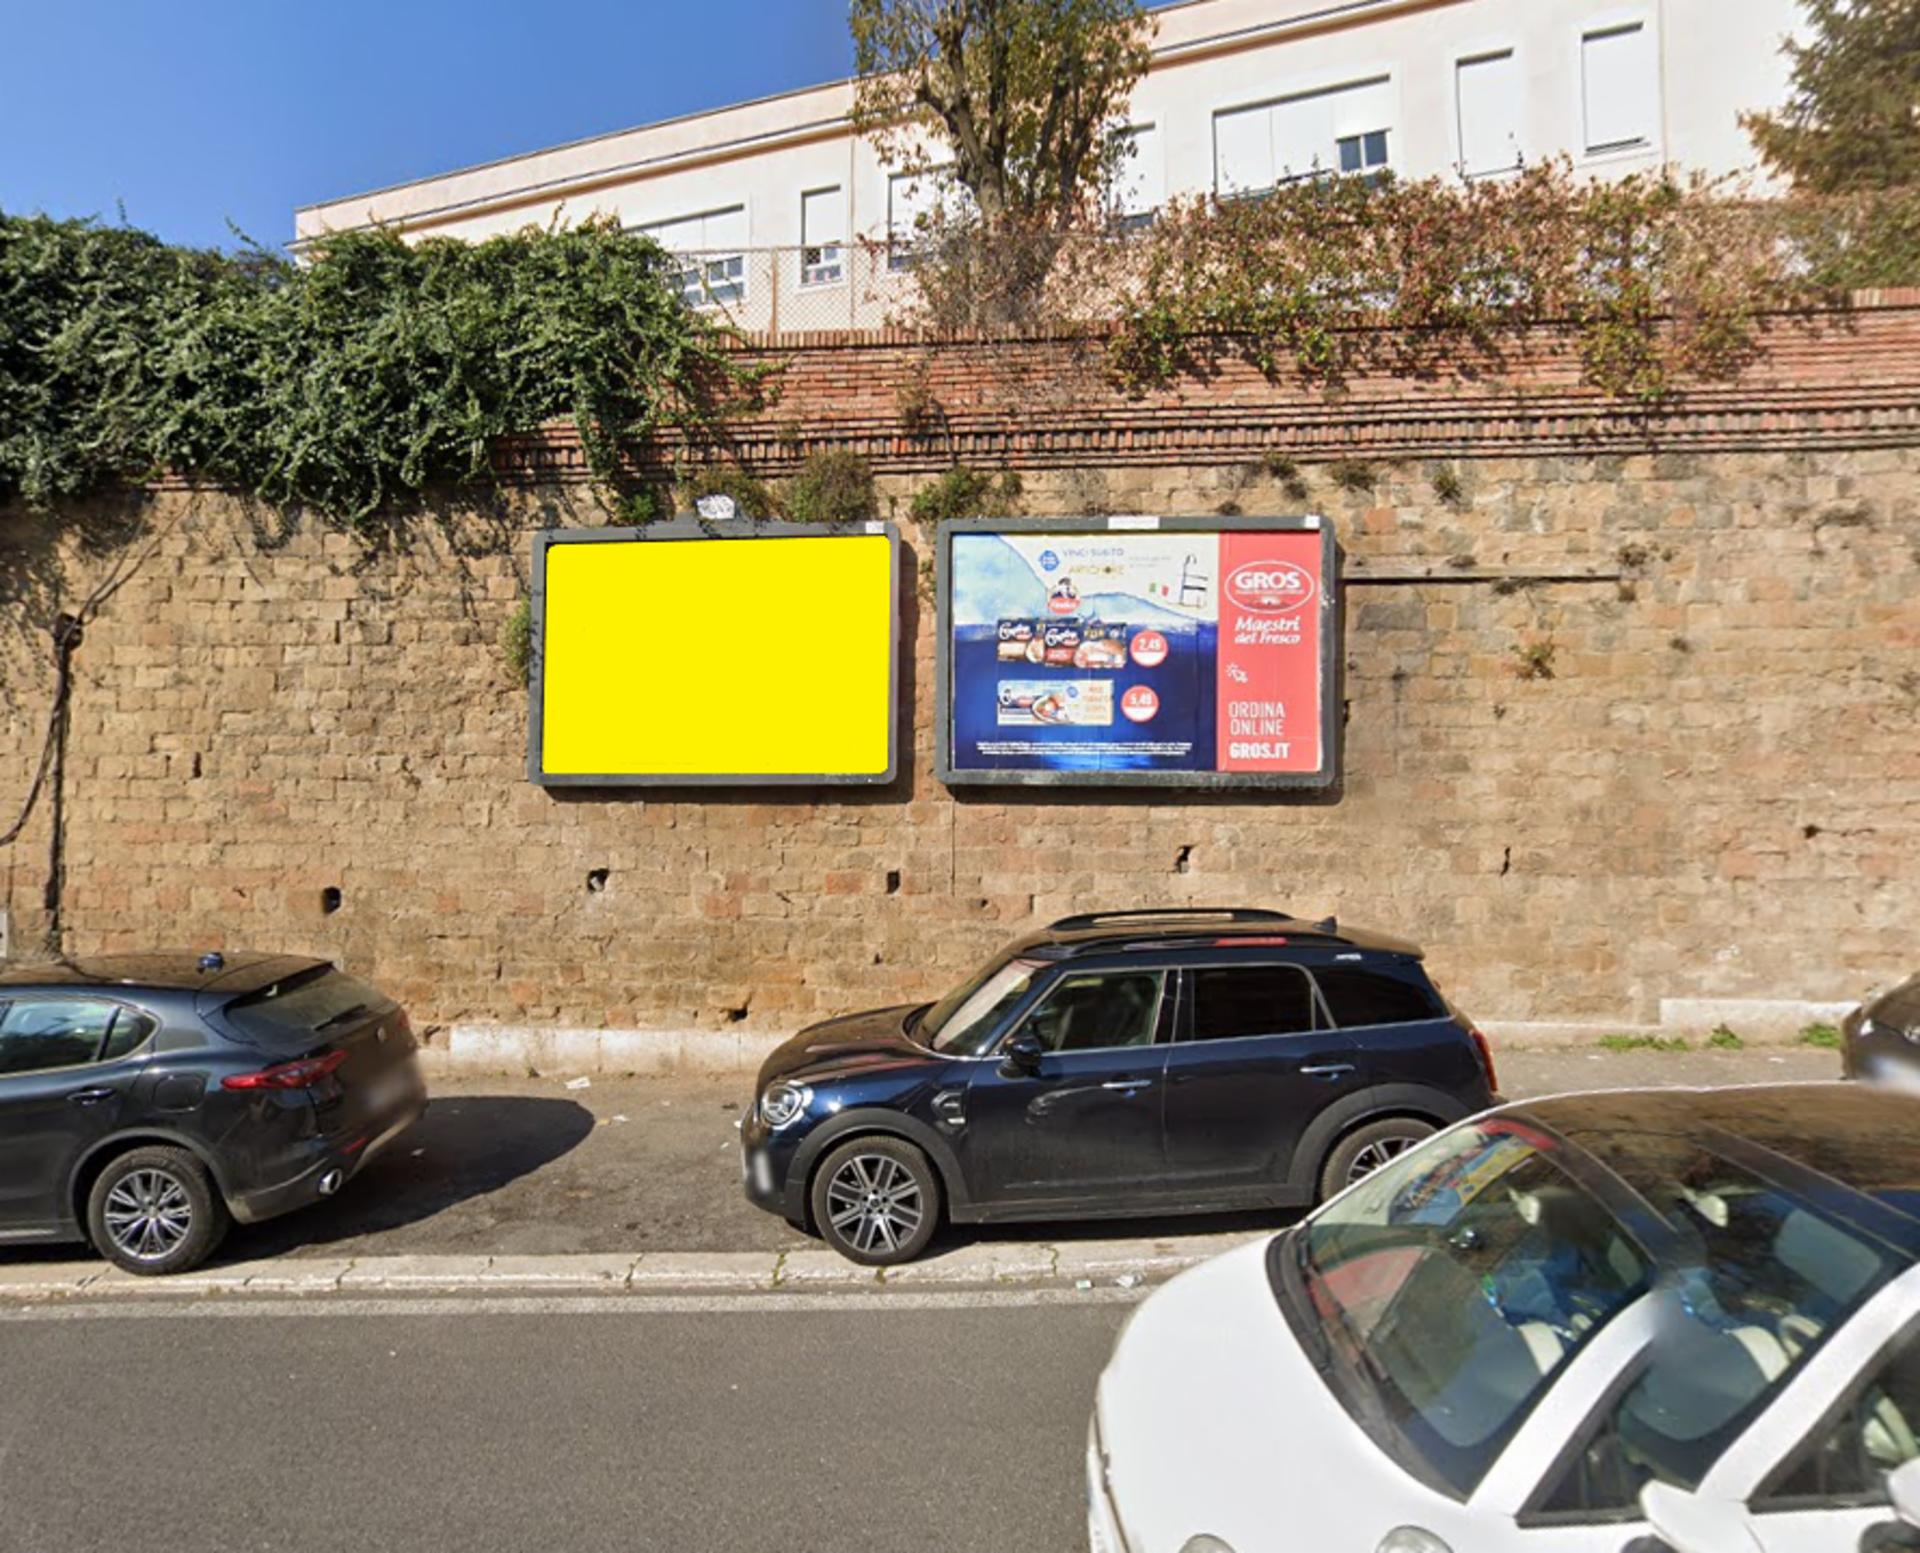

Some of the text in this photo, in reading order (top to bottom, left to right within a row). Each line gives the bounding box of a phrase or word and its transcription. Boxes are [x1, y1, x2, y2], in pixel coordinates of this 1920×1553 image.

[1234, 571, 1301, 590] GROS
[1234, 615, 1301, 631] Maestri
[1234, 631, 1257, 645] del
[1228, 700, 1286, 718] ORDINA
[1230, 718, 1284, 736] ONLINE
[1229, 742, 1291, 759] GROS.IT
